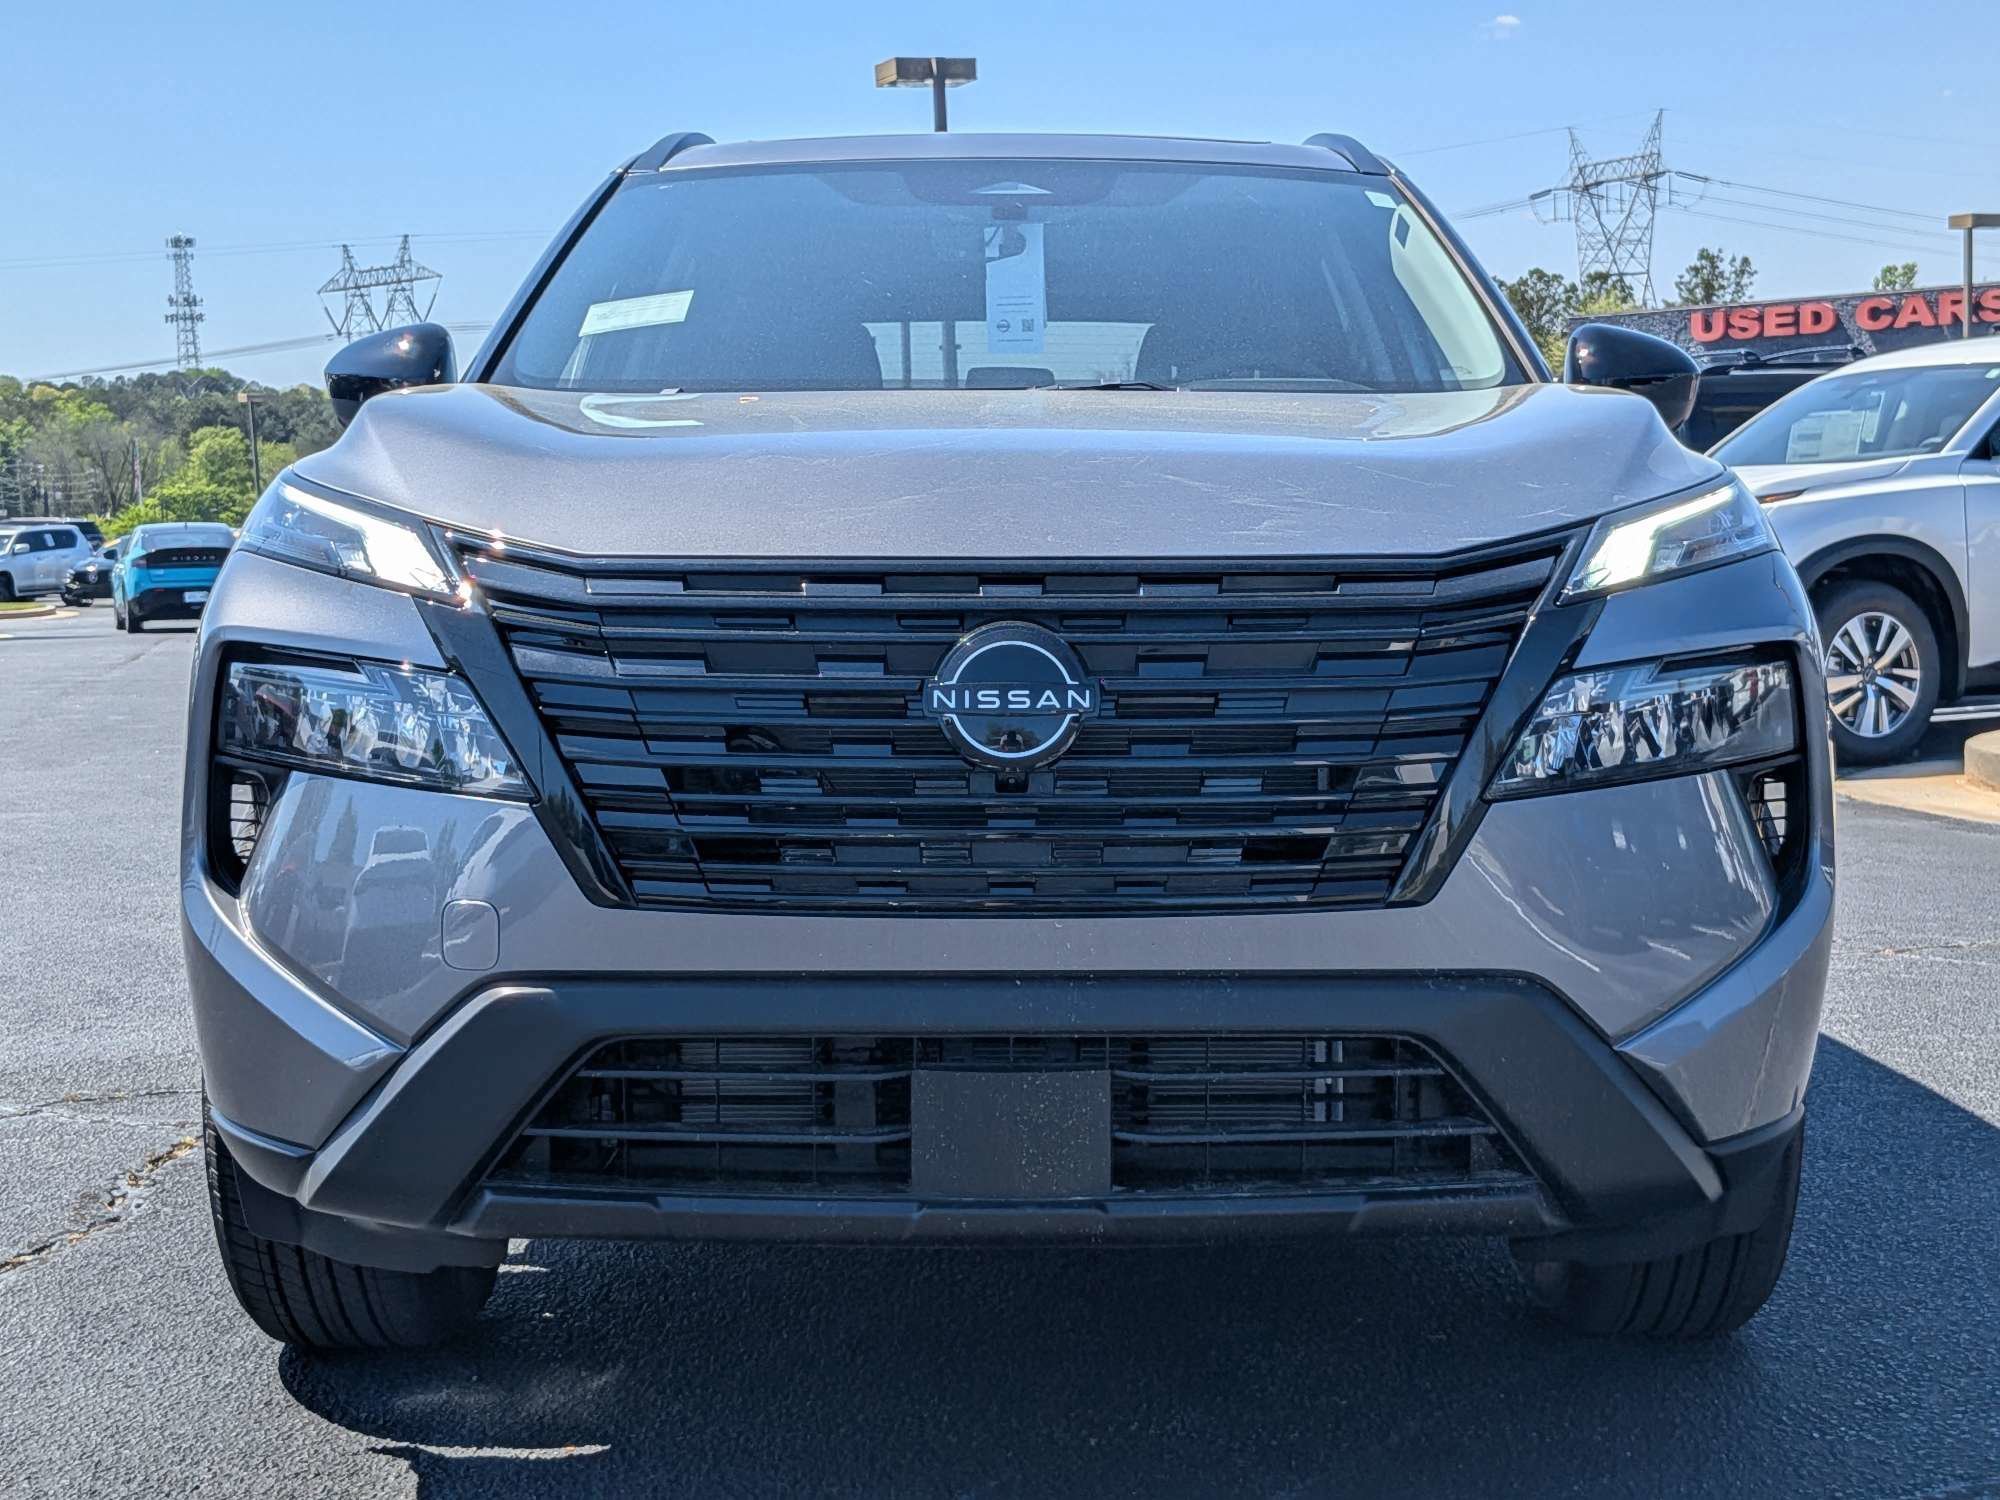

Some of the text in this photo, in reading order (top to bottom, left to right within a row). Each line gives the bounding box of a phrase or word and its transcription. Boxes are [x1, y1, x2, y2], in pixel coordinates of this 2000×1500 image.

[1689, 288, 2000, 342] USED CARS
[932, 689, 1091, 709] NISSAN
